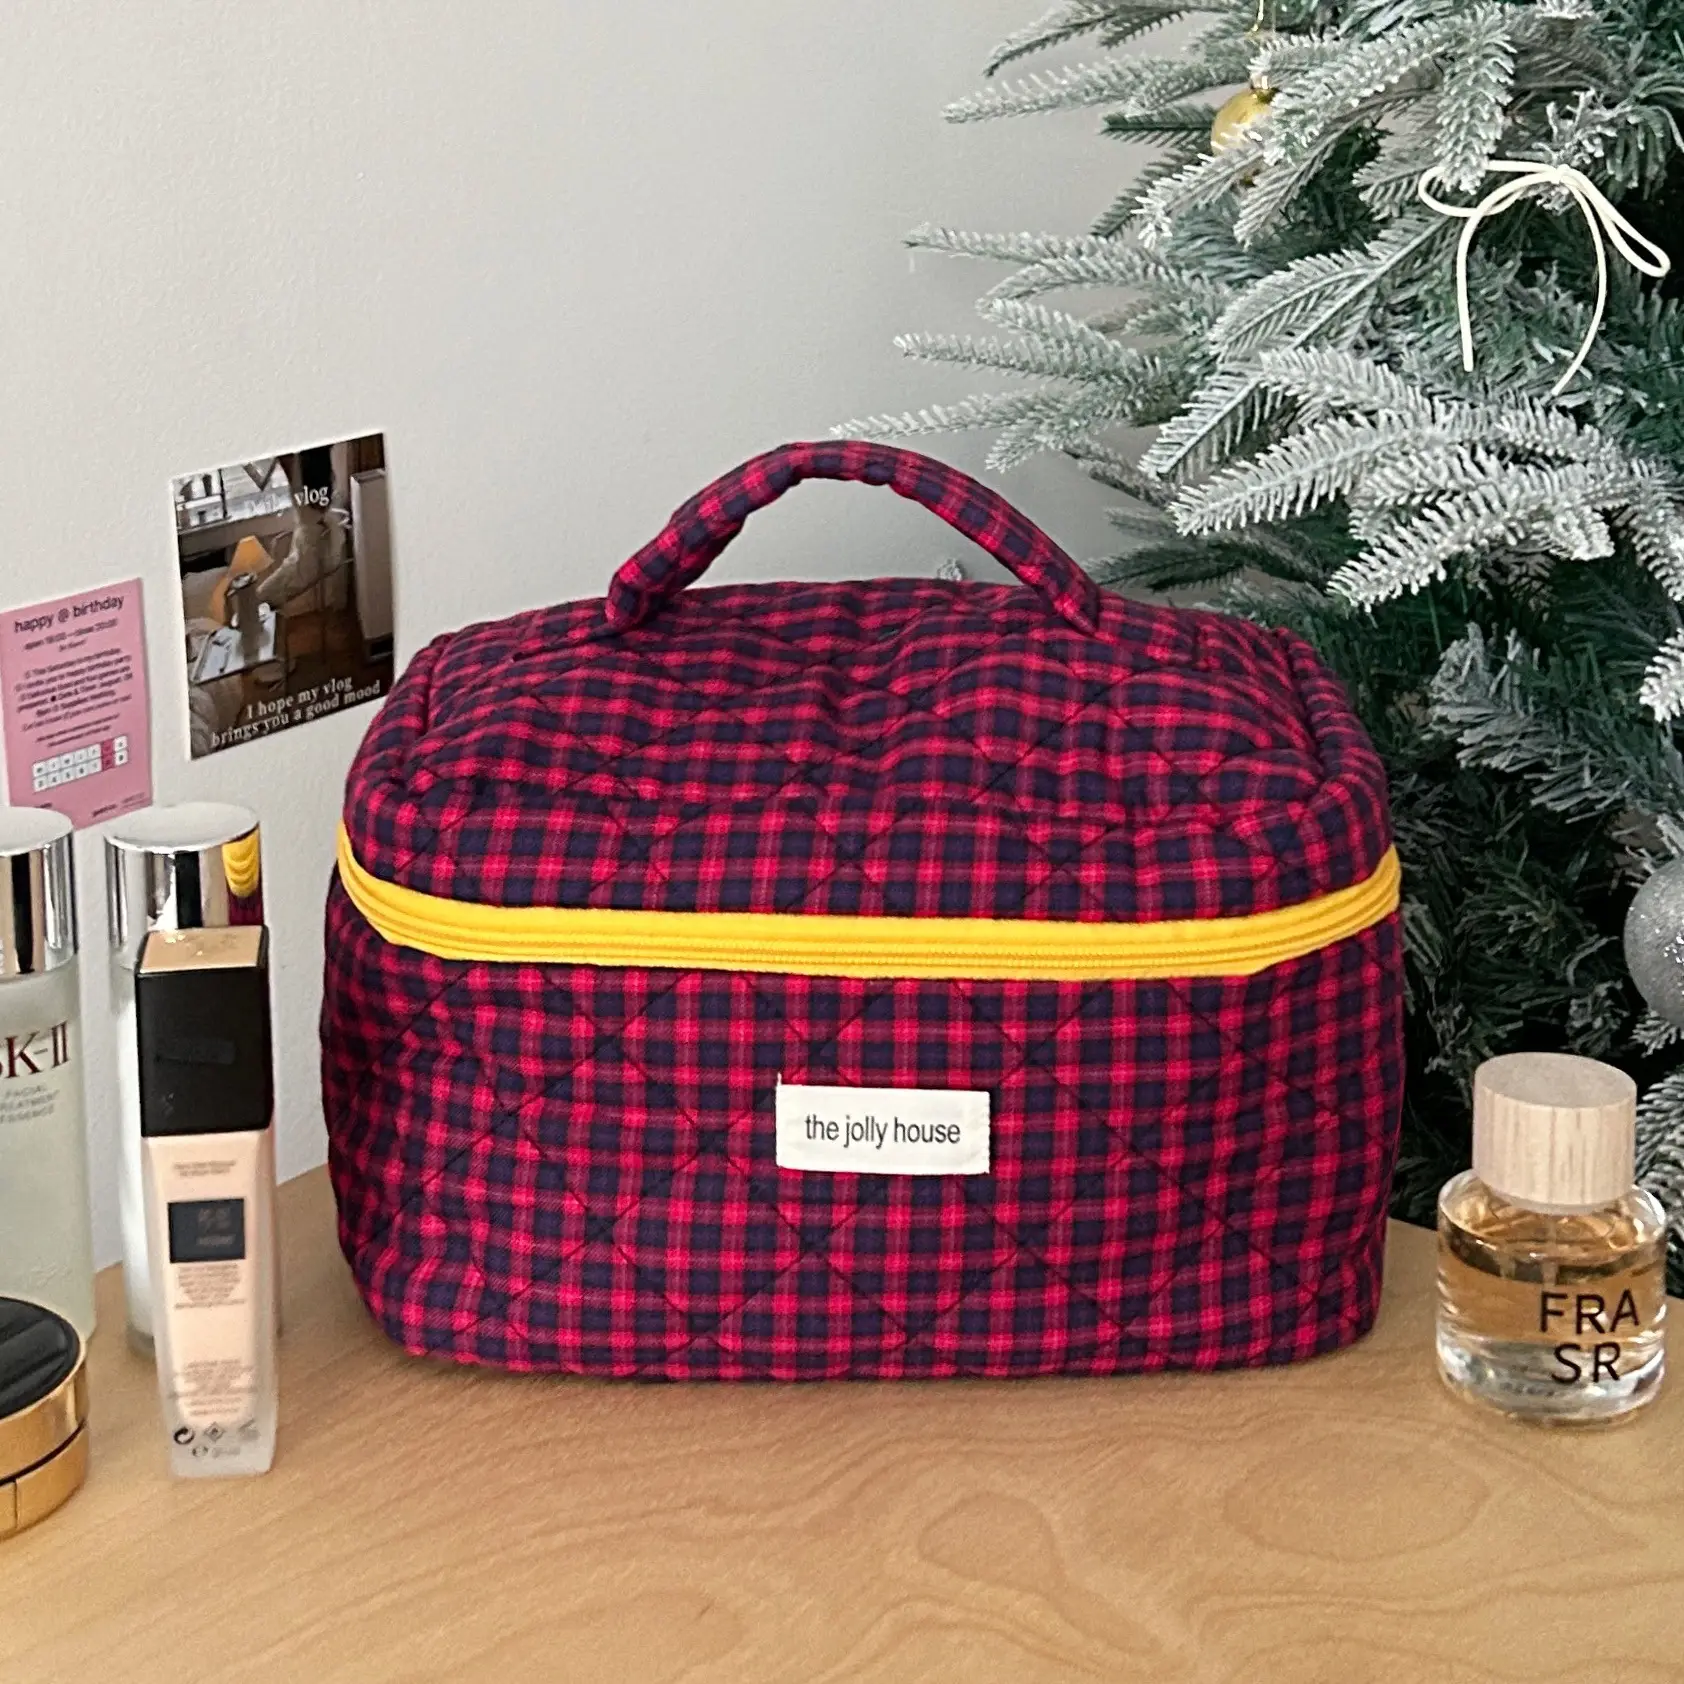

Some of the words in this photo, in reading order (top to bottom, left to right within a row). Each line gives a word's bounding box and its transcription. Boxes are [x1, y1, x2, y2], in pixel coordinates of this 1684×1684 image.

[293, 484, 330, 507] vlog
[13, 613, 54, 633] happy
[72, 596, 124, 617] birthday
[211, 724, 260, 748] brings
[260, 712, 290, 735] you
[305, 694, 340, 720] good
[344, 680, 381, 704] mood
[257, 695, 294, 718] hope
[296, 688, 319, 705] my
[323, 677, 353, 695] vlog
[0, 1020, 70, 1079] K-II
[805, 1114, 840, 1141] the
[843, 1114, 889, 1150] jolly
[893, 1116, 962, 1144] house
[1539, 1288, 1640, 1335] FRA
[1551, 1341, 1621, 1385] SR
